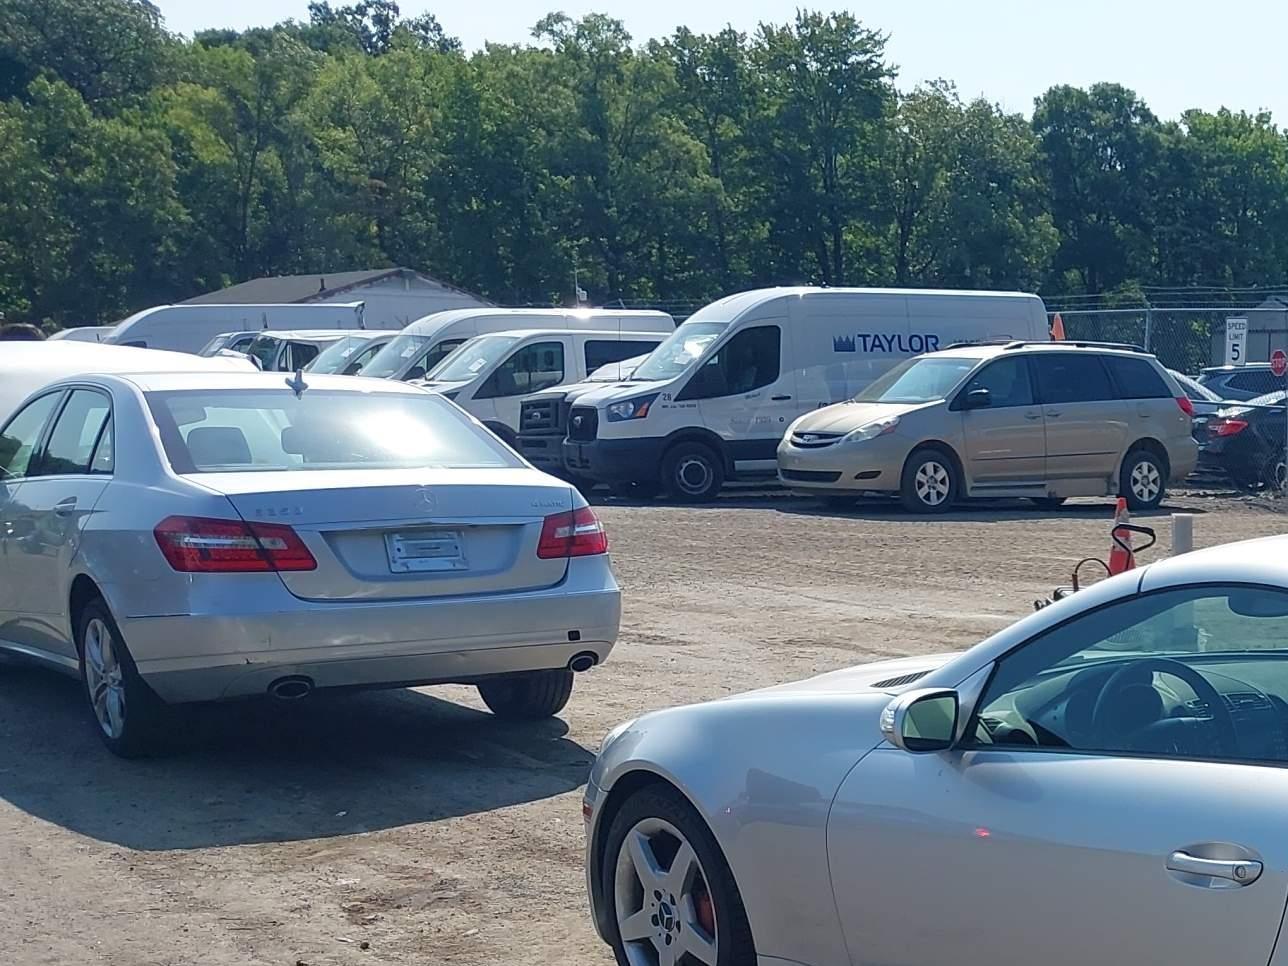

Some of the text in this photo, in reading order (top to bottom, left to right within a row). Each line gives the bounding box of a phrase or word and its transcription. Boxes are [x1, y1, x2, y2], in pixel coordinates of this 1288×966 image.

[1228, 322, 1246, 330] SPEED
[1229, 333, 1243, 341] LIMIT
[857, 333, 939, 353] TAYLOR
[1231, 343, 1240, 361] 5
[1271, 358, 1287, 368] STOP
